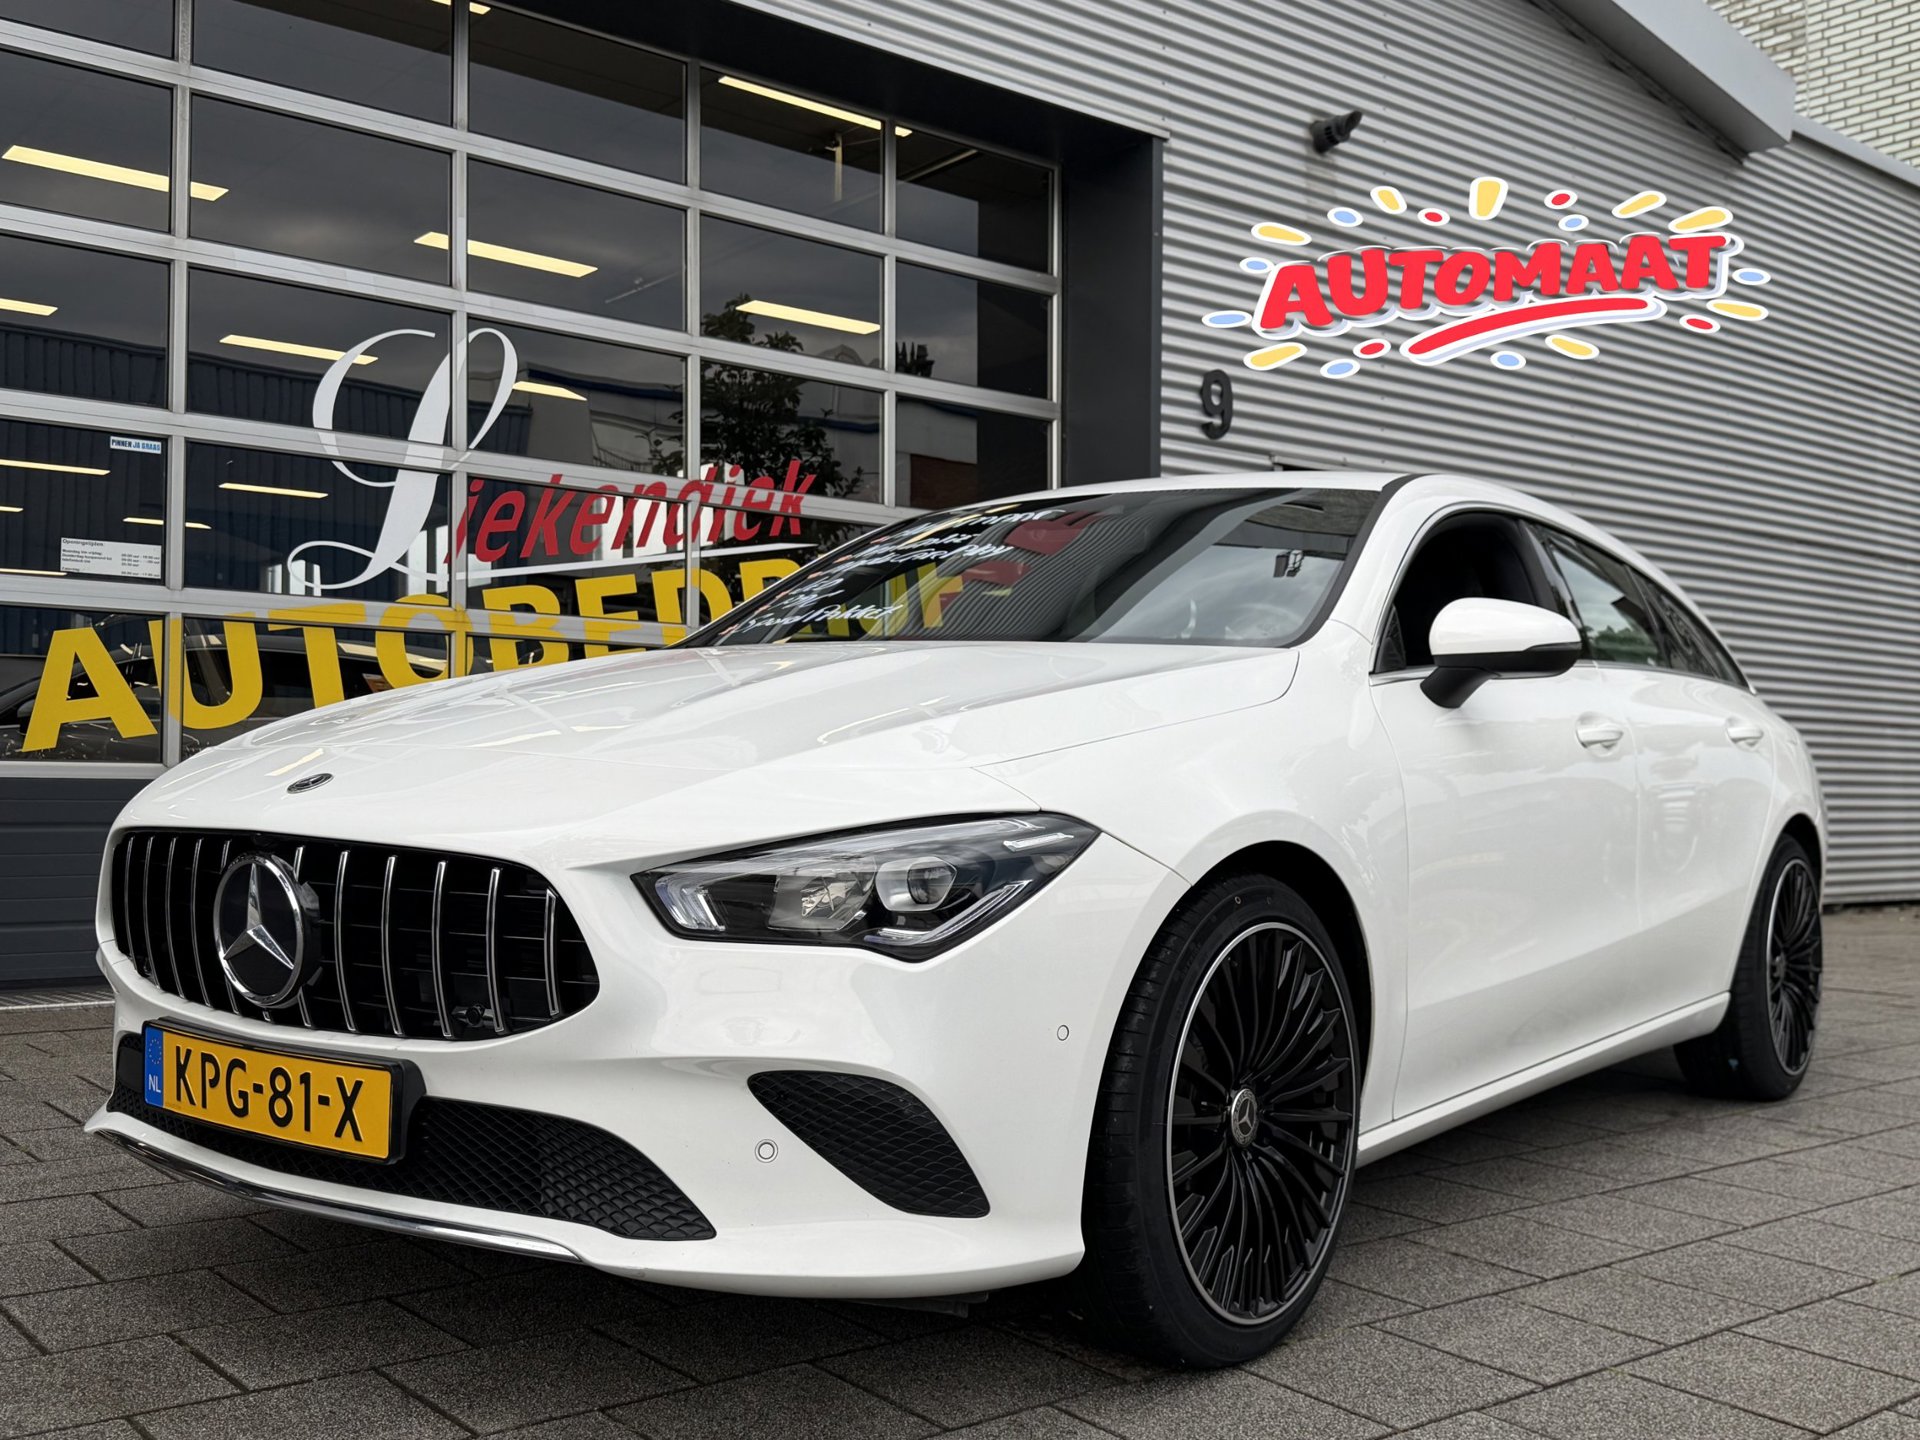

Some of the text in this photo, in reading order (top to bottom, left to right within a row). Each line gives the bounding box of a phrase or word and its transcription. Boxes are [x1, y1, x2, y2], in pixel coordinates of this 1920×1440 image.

[1200, 369, 1233, 440] 9
[288, 328, 818, 590] Liekendiek
[148, 1045, 364, 1143] NL KPG-81-X
